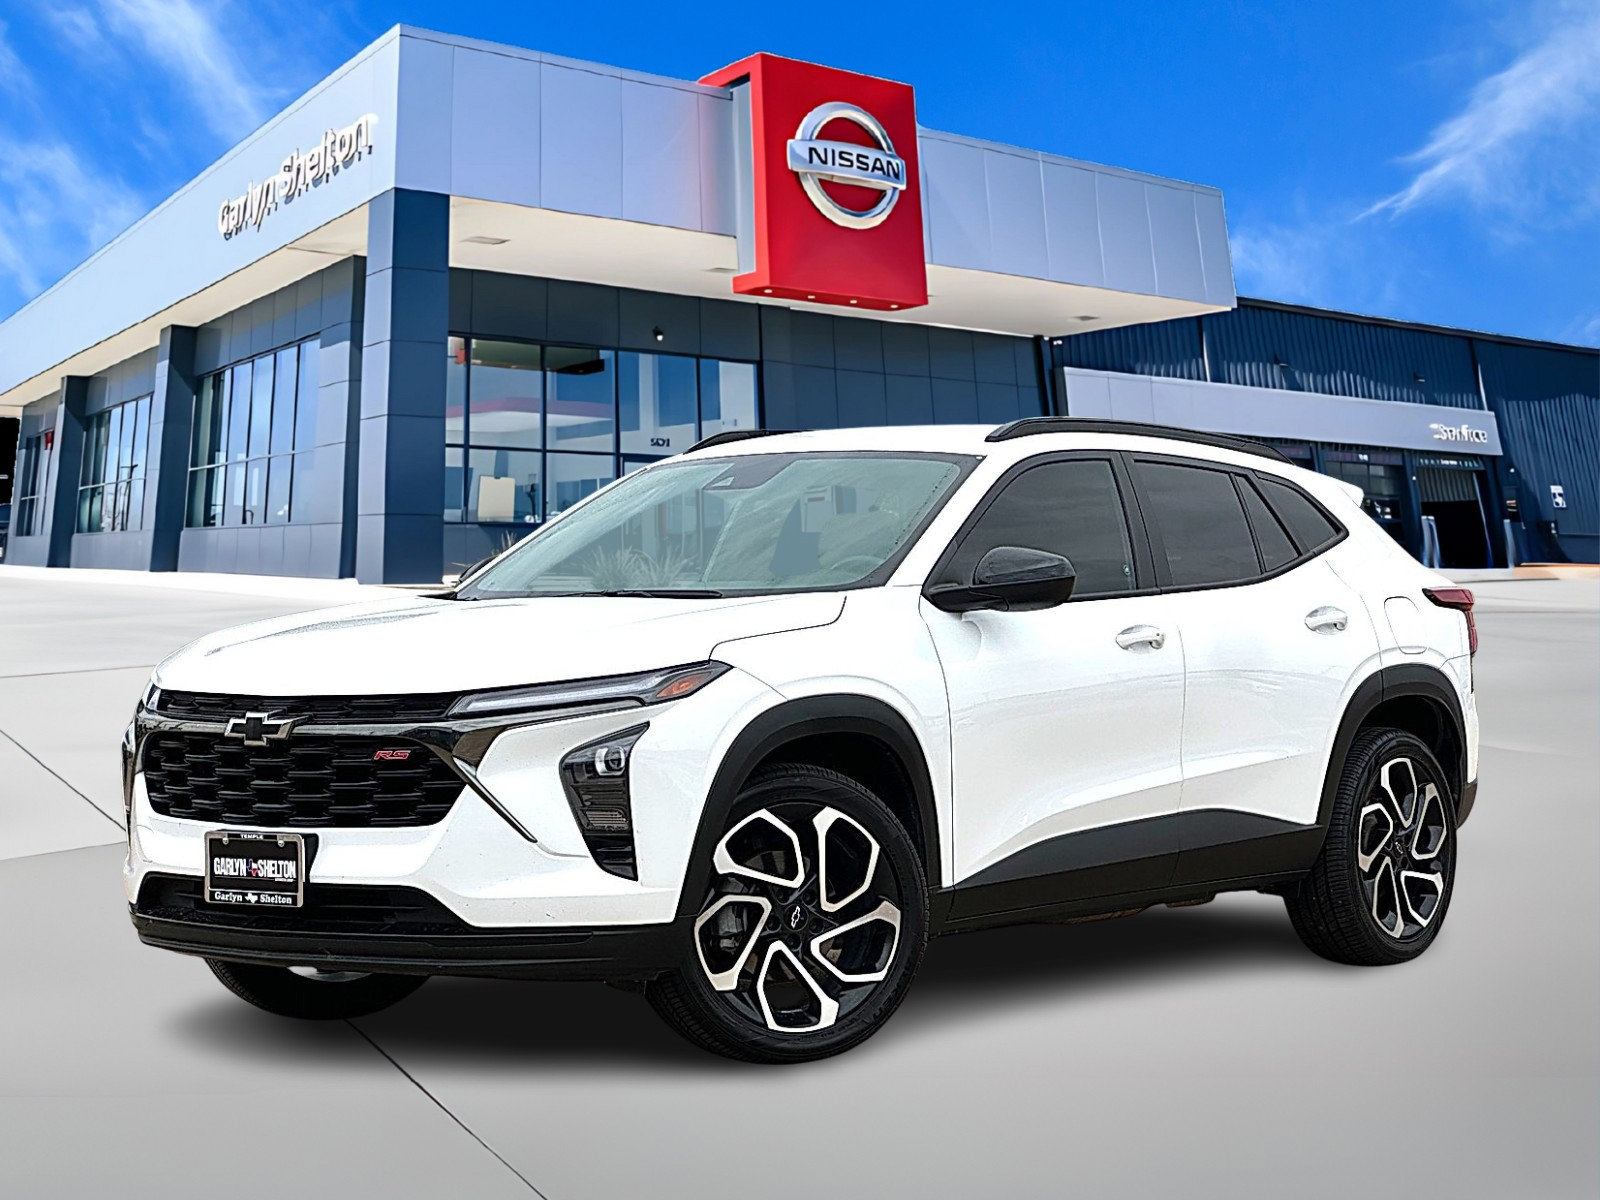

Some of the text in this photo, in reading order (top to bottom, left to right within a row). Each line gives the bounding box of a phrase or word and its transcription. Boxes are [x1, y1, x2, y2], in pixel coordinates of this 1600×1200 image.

[278, 113, 378, 205] Shelton
[808, 146, 901, 181] NISSAN
[374, 750, 411, 760] RS
[213, 857, 297, 879] GARLYN SHELTON
[214, 891, 292, 905] Garlyn Shelton
